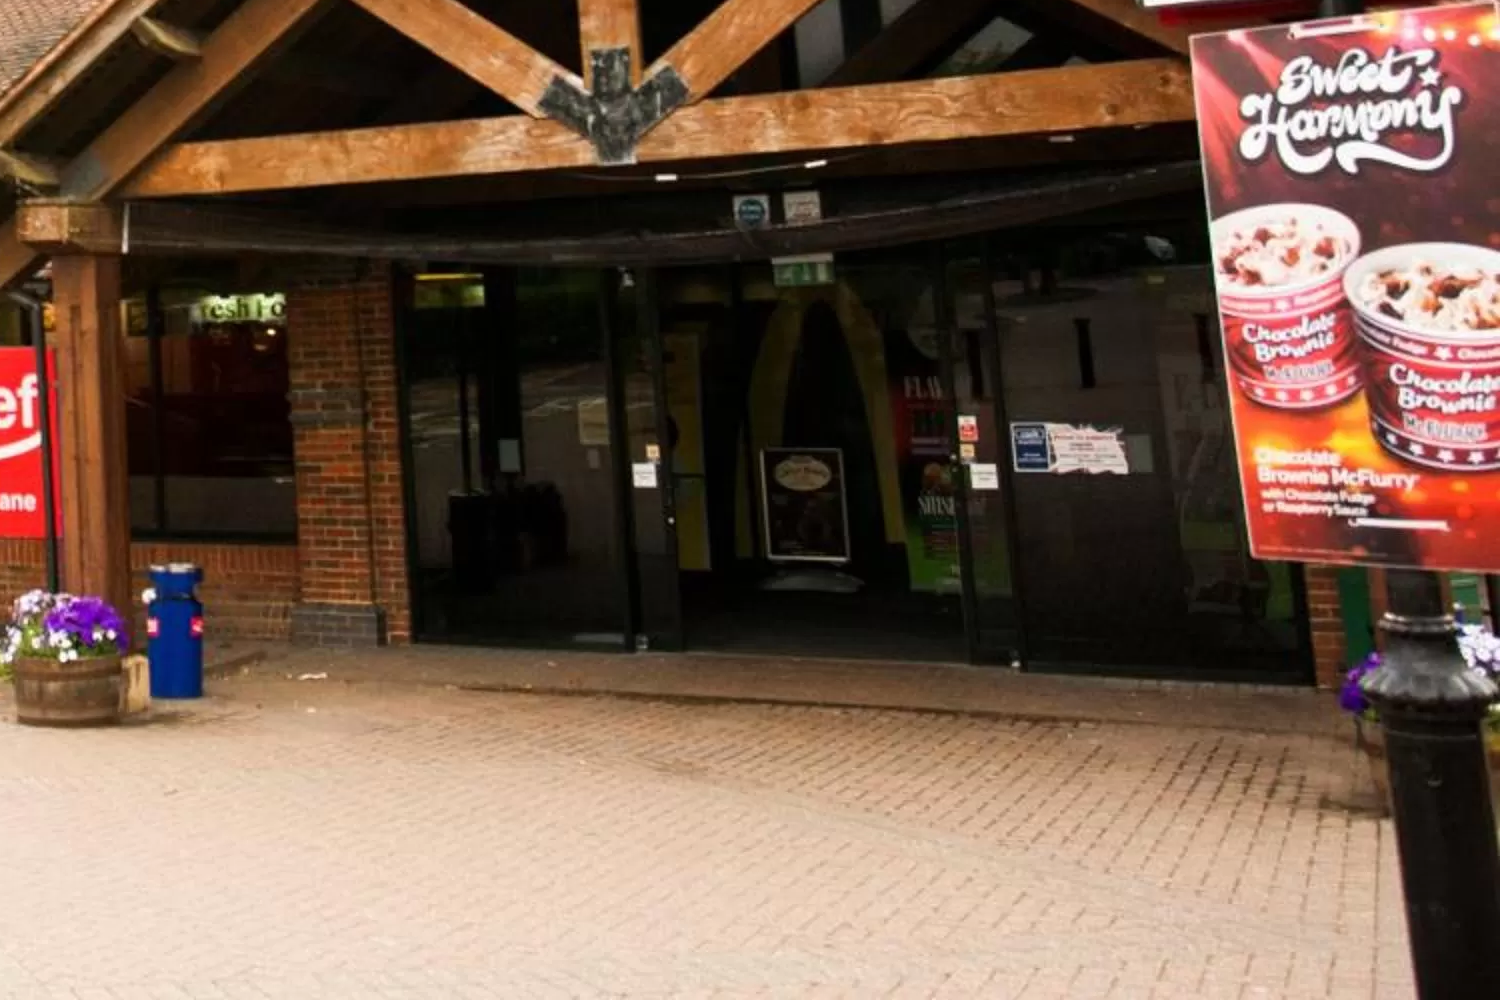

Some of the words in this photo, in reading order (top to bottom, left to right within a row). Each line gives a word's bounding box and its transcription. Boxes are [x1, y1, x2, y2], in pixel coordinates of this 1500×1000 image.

[1277, 45, 1435, 105] Sweet
[1239, 86, 1462, 175] Harmony
[1242, 312, 1336, 344] Chocolate
[1254, 331, 1334, 363] Brownie
[1398, 387, 1496, 414] Brownie
[1255, 446, 1341, 467] Chocolate
[1257, 466, 1329, 485] Brownie
